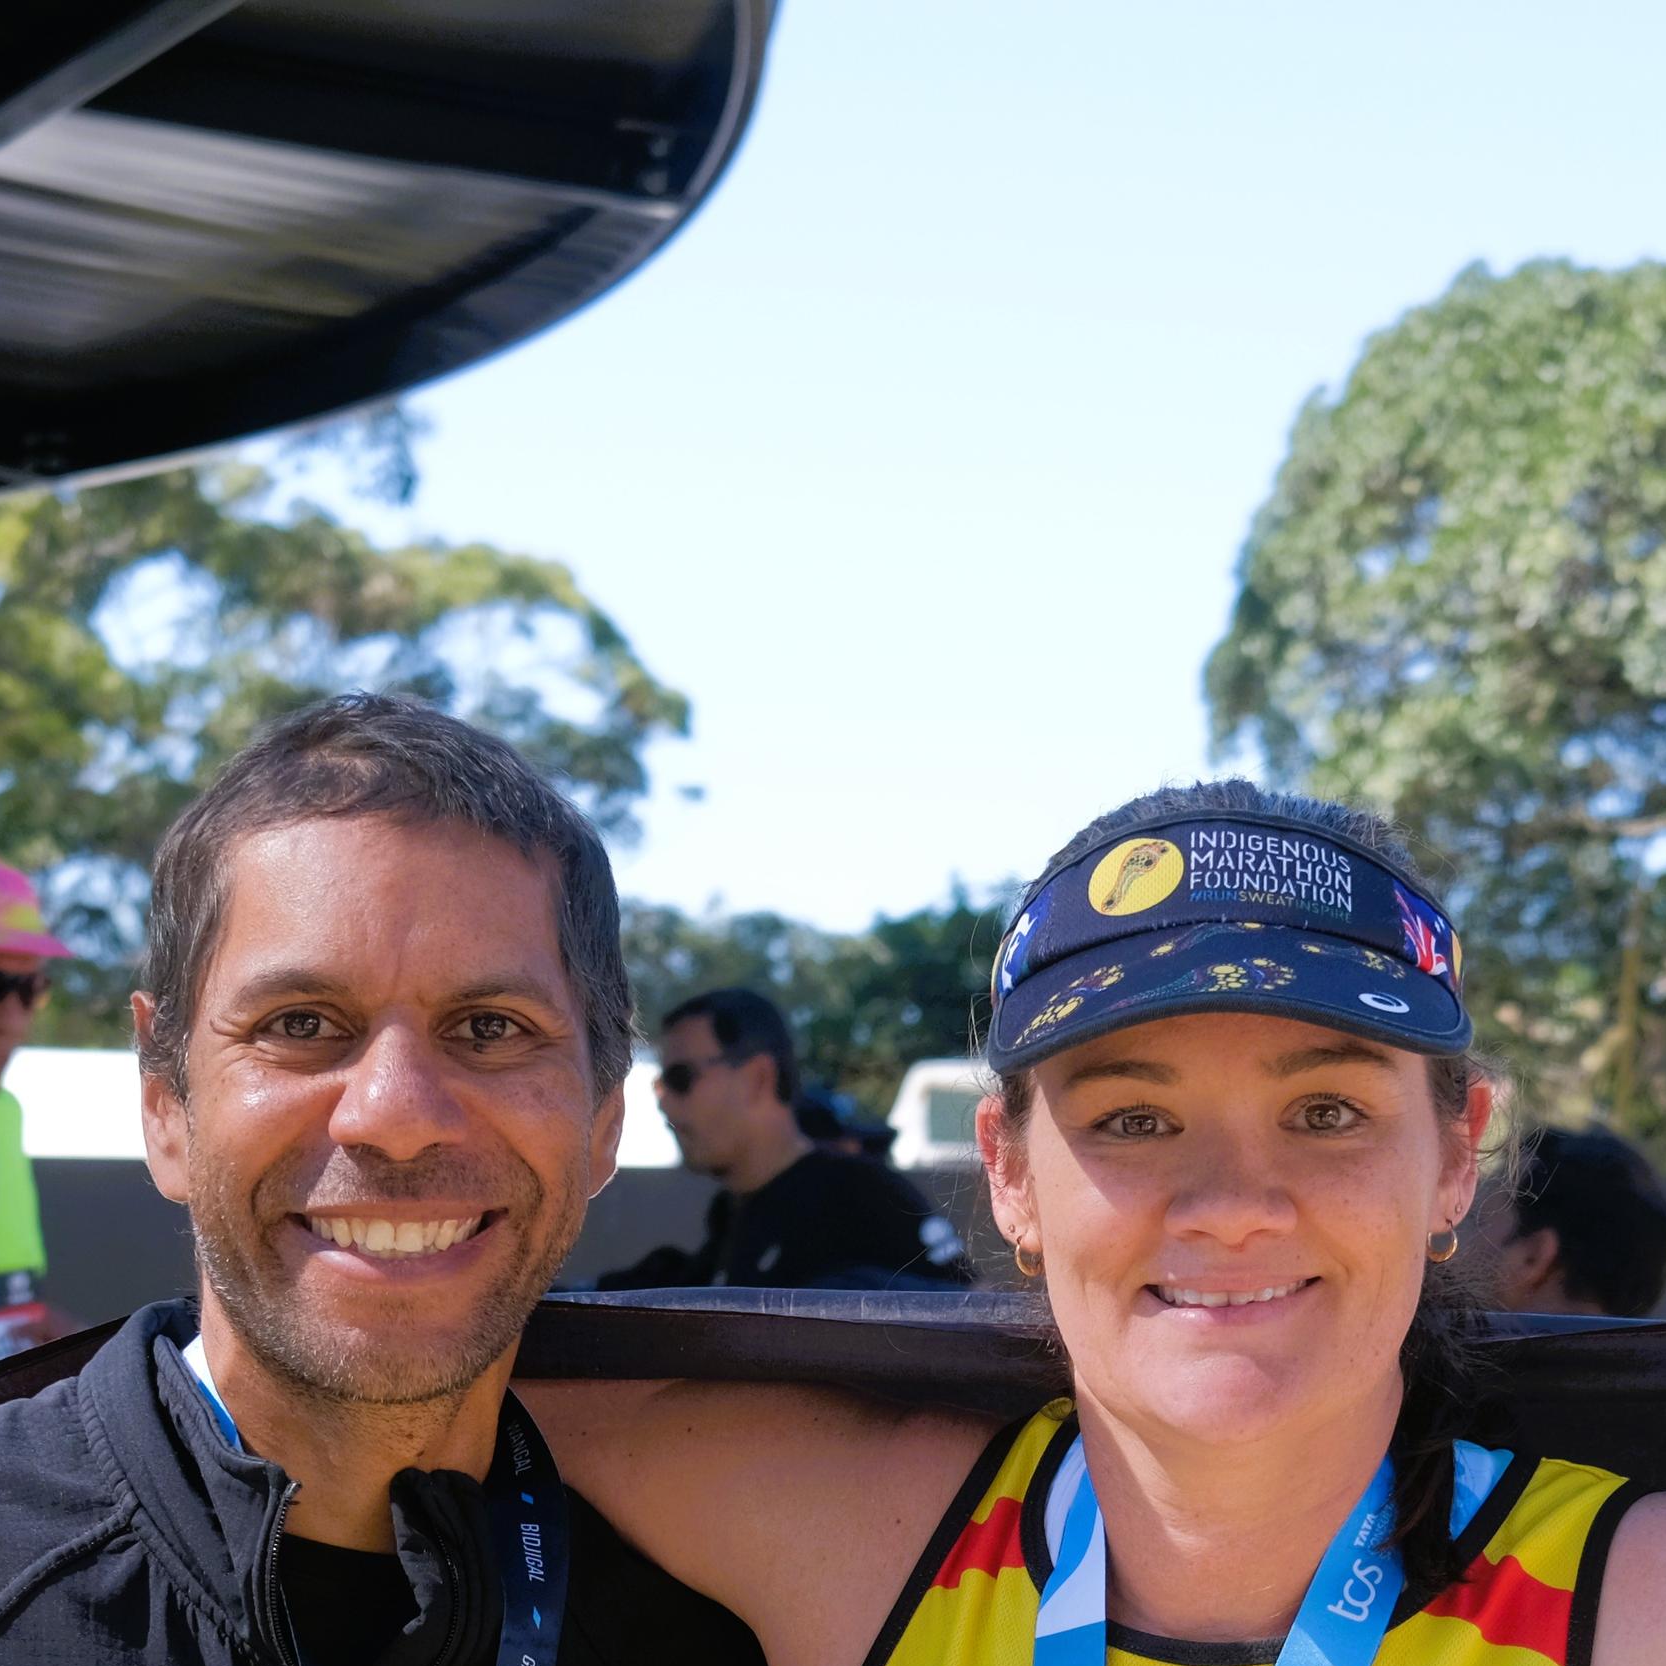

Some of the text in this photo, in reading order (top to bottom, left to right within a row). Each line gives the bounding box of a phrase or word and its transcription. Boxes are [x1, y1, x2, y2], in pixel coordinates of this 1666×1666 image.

[1190, 830, 1351, 873] INDIGENOUS
[1190, 850, 1352, 893] MARATHON
[1190, 870, 1353, 913] FOUNDATION
[520, 1523, 545, 1582] BIDJIGAL
[1327, 1558, 1383, 1622] tcs
